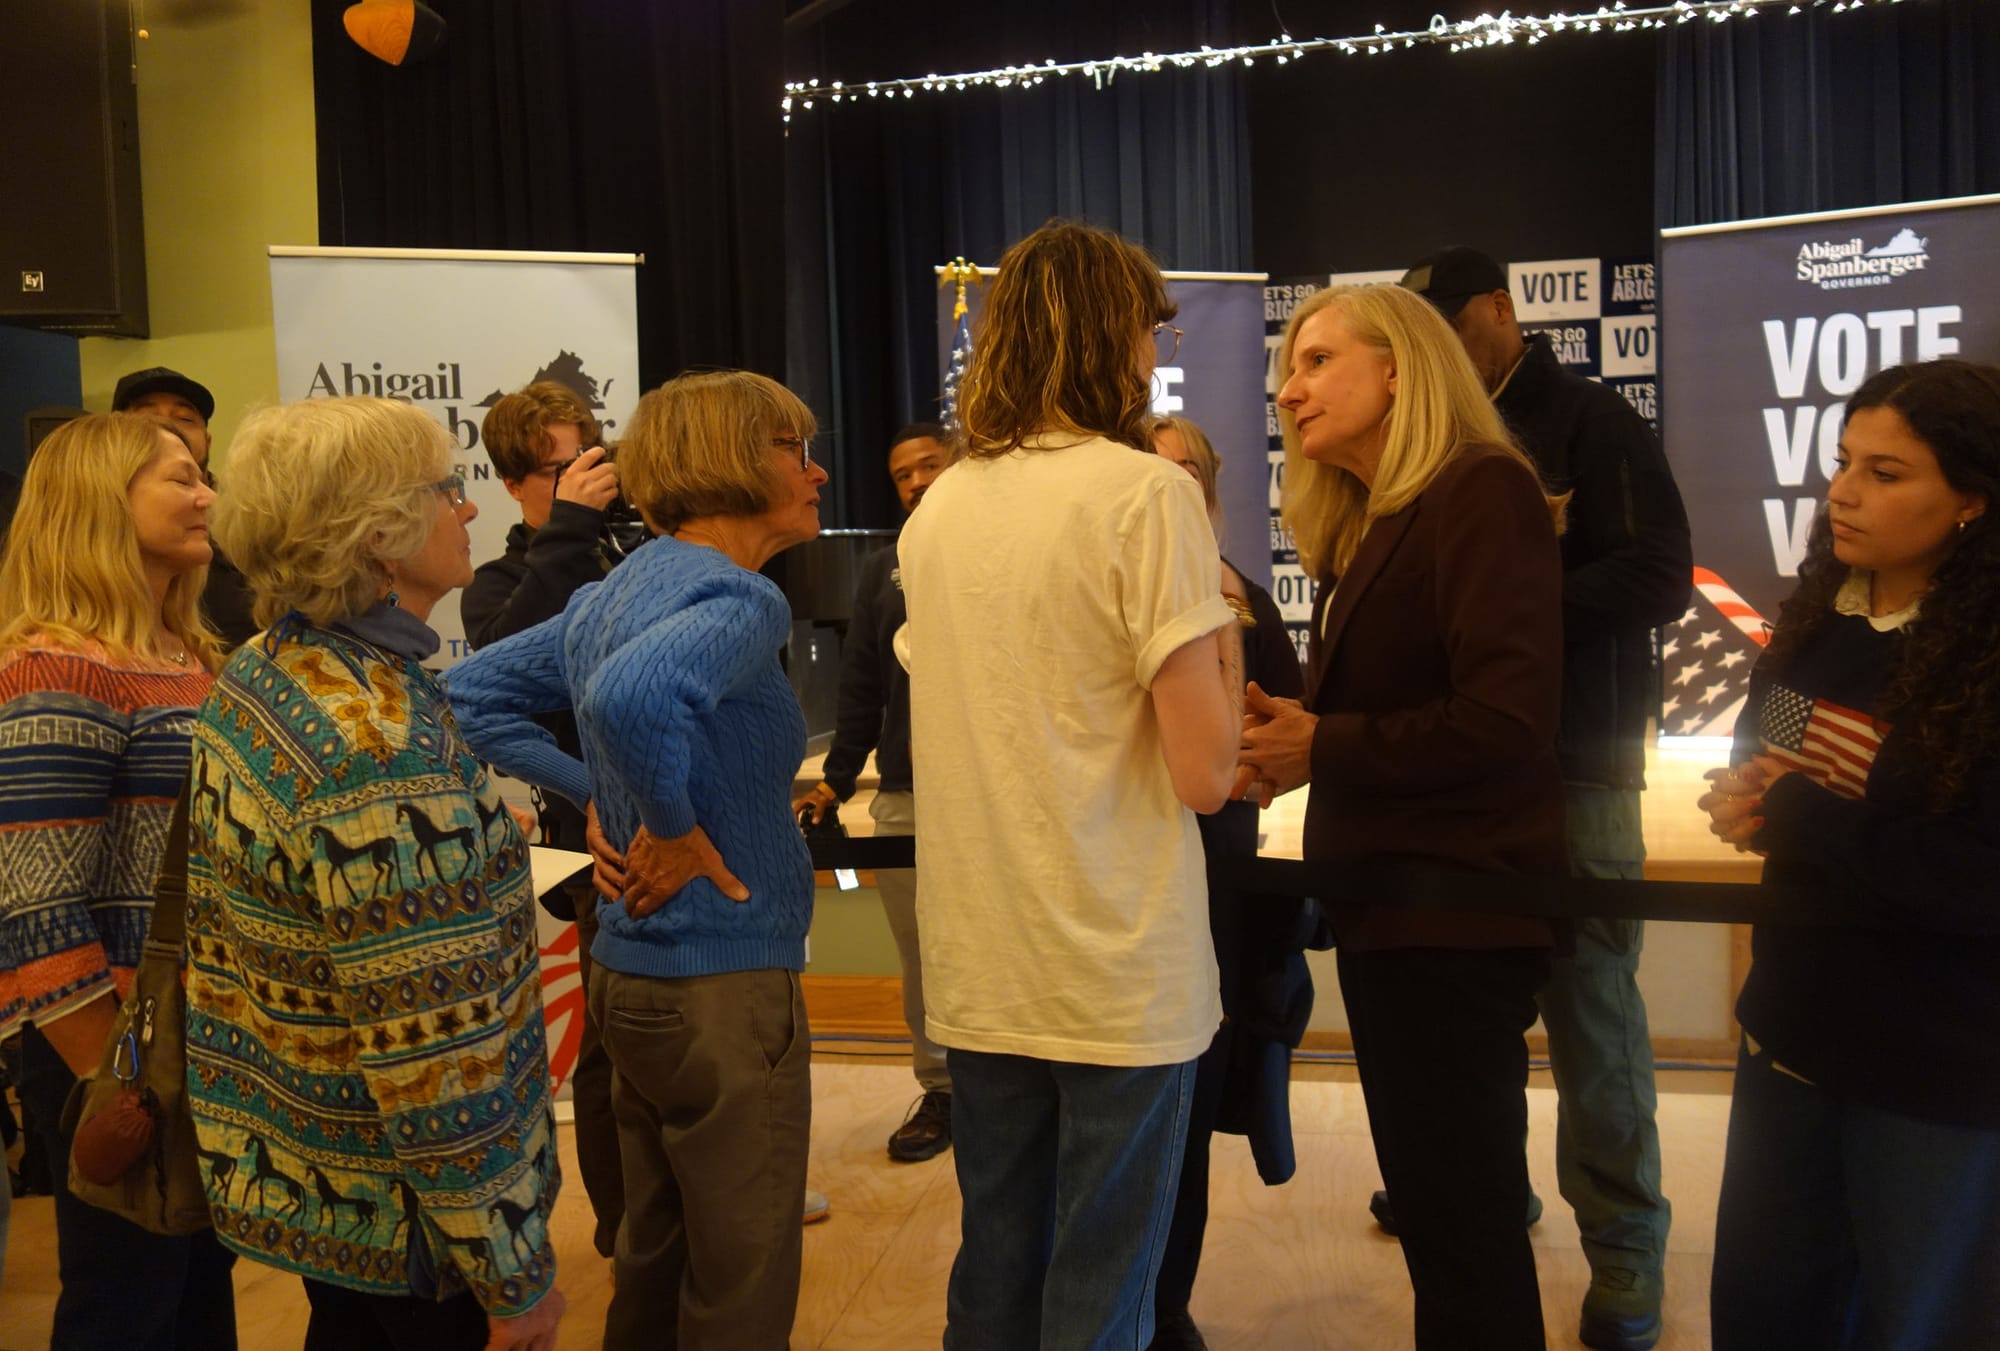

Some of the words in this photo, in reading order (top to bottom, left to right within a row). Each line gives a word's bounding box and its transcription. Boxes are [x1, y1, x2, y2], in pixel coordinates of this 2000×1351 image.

[1797, 238, 1863, 261] Abigail
[1614, 264, 1655, 280] LET'S
[1797, 253, 1930, 283] Spanberger
[1264, 285, 1293, 300] ET'S
[1521, 271, 1589, 304] VOTE
[1612, 279, 1655, 302] ABIG
[1821, 275, 1891, 290] GOVERNOR
[1564, 327, 1587, 342] GO
[1614, 325, 1655, 358] VO
[1552, 342, 1591, 365] GAIL
[1762, 305, 1962, 399] VOTE
[305, 361, 464, 405] Abigail
